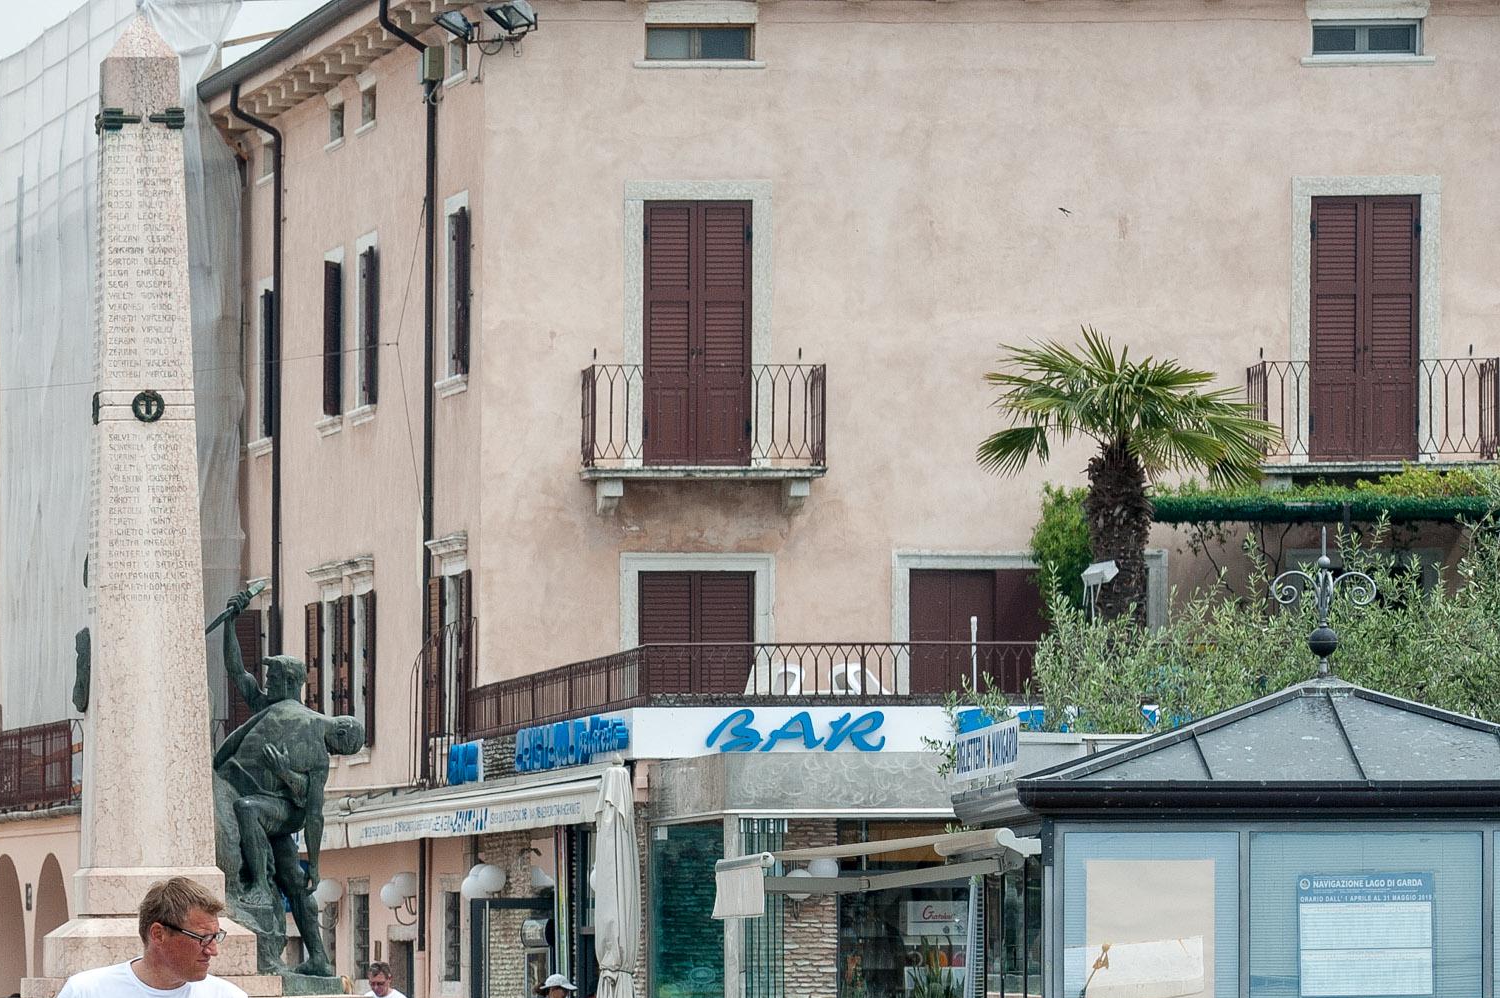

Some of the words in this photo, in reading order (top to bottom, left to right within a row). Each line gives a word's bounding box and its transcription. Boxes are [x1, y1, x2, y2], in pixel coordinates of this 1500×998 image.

[137, 212, 164, 220] LEONE
[107, 269, 129, 277] SEGA
[136, 269, 165, 277] ENRICO
[107, 280, 129, 288] SEGA
[136, 280, 172, 288] GIUSEPPE
[705, 708, 886, 753] BAR
[1312, 879, 1364, 889] NAVIGAZIONE
[1365, 879, 1386, 888] LAGO
[1387, 879, 1395, 887] DI
[1396, 878, 1423, 887] GARDA
[1300, 895, 1324, 903] ORARIO
[1392, 894, 1417, 902] MAGGIO
